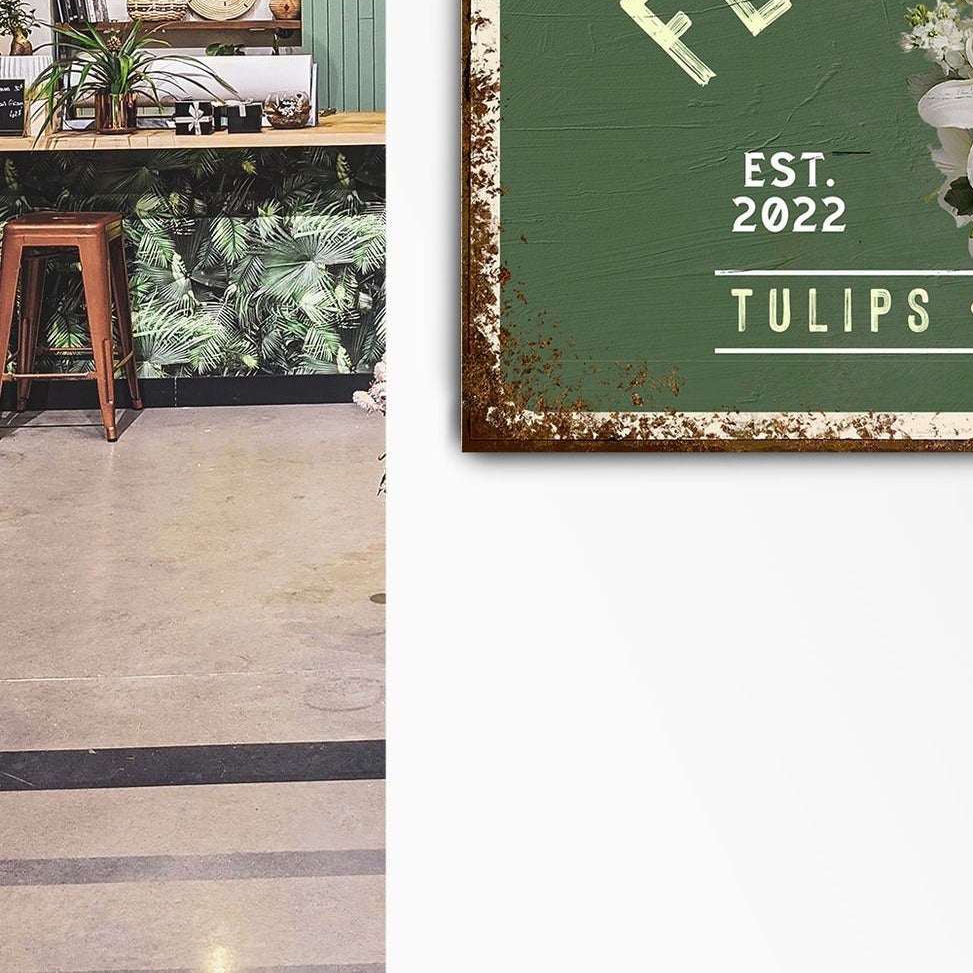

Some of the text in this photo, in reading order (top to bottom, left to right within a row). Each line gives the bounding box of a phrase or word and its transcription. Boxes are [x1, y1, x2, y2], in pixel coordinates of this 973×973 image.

[744, 152, 836, 188] EST.
[732, 196, 847, 233] 2022
[731, 288, 930, 333] TULIPS
